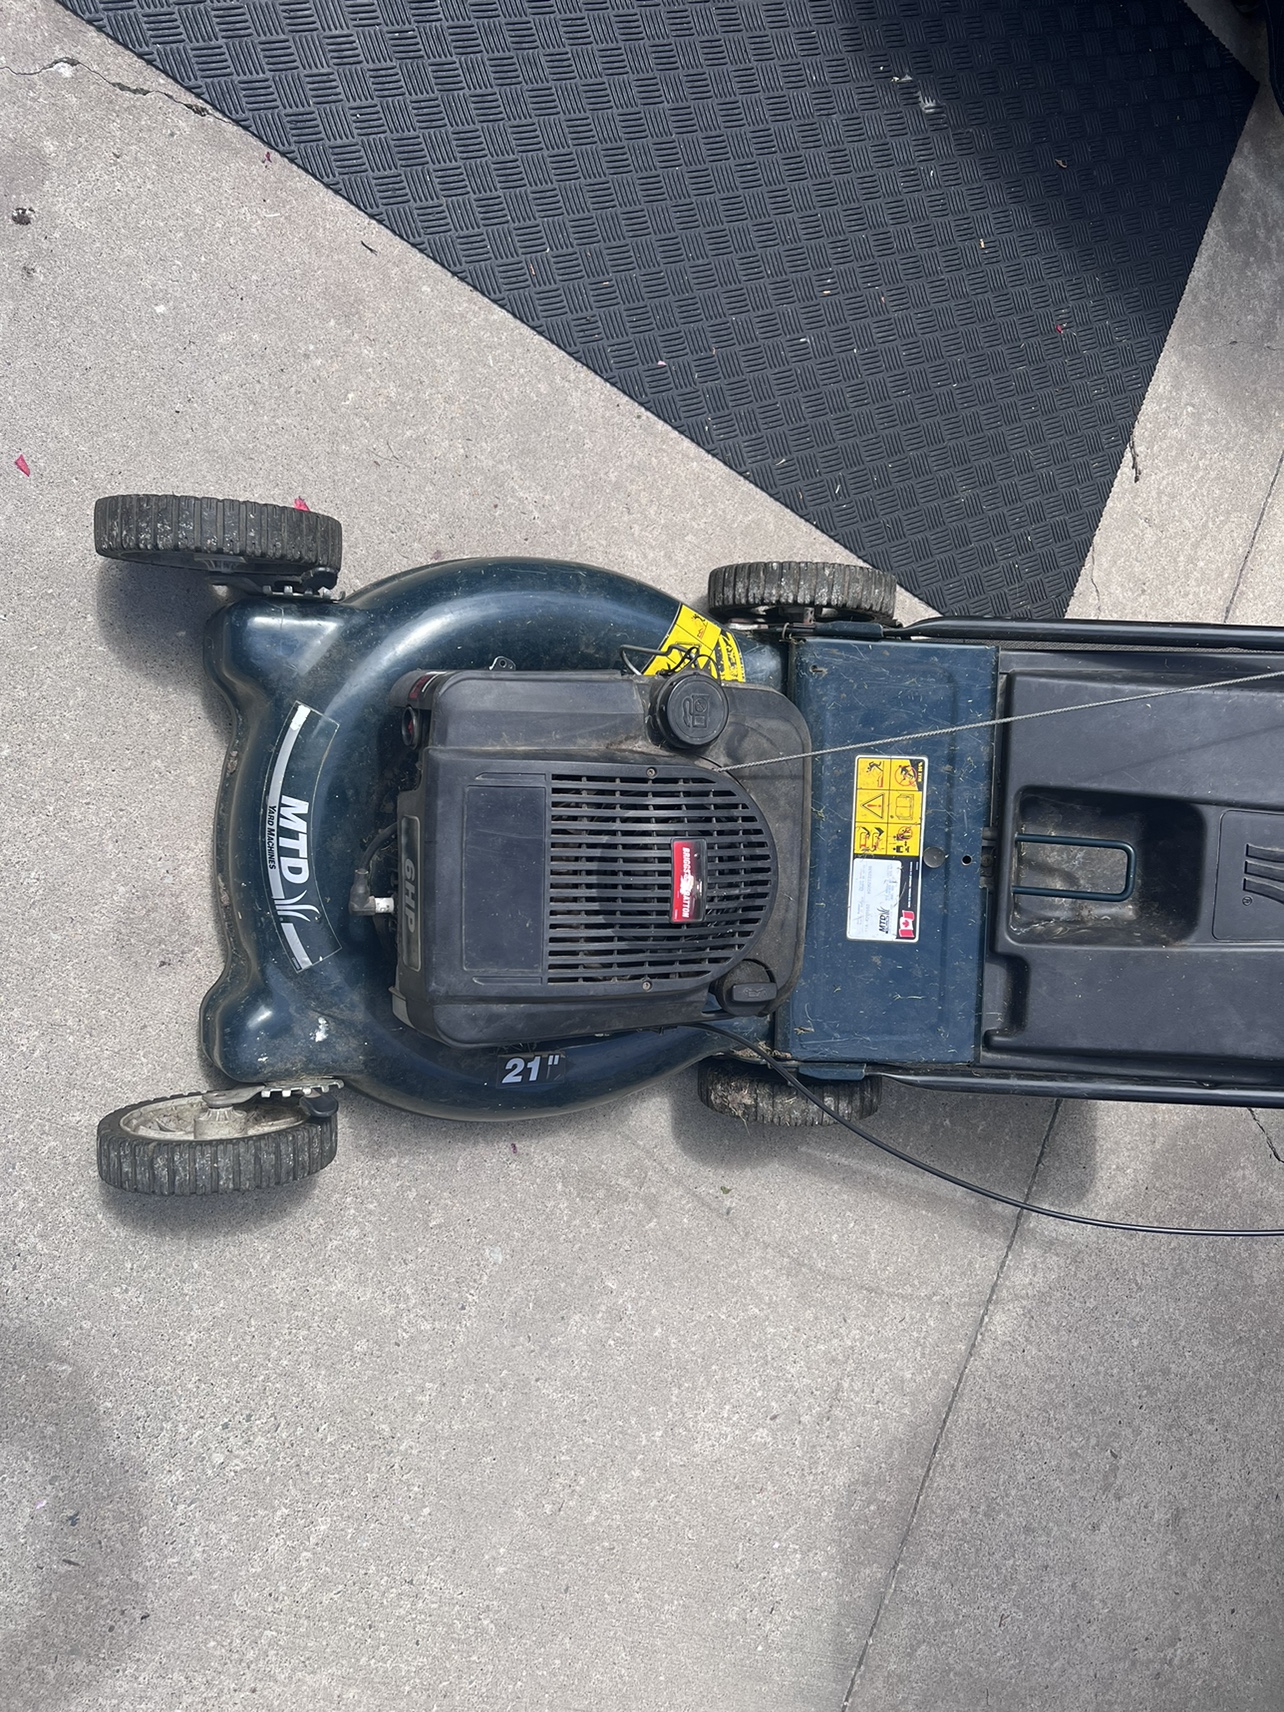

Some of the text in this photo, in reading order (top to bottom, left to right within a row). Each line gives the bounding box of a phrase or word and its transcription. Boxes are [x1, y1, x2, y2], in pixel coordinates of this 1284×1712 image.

[266, 805, 277, 870] YARD MACHINES
[279, 795, 310, 885] MTD
[682, 847, 691, 873] BRIGGS
[404, 858, 416, 933] 6HP
[878, 914, 886, 932] MTD
